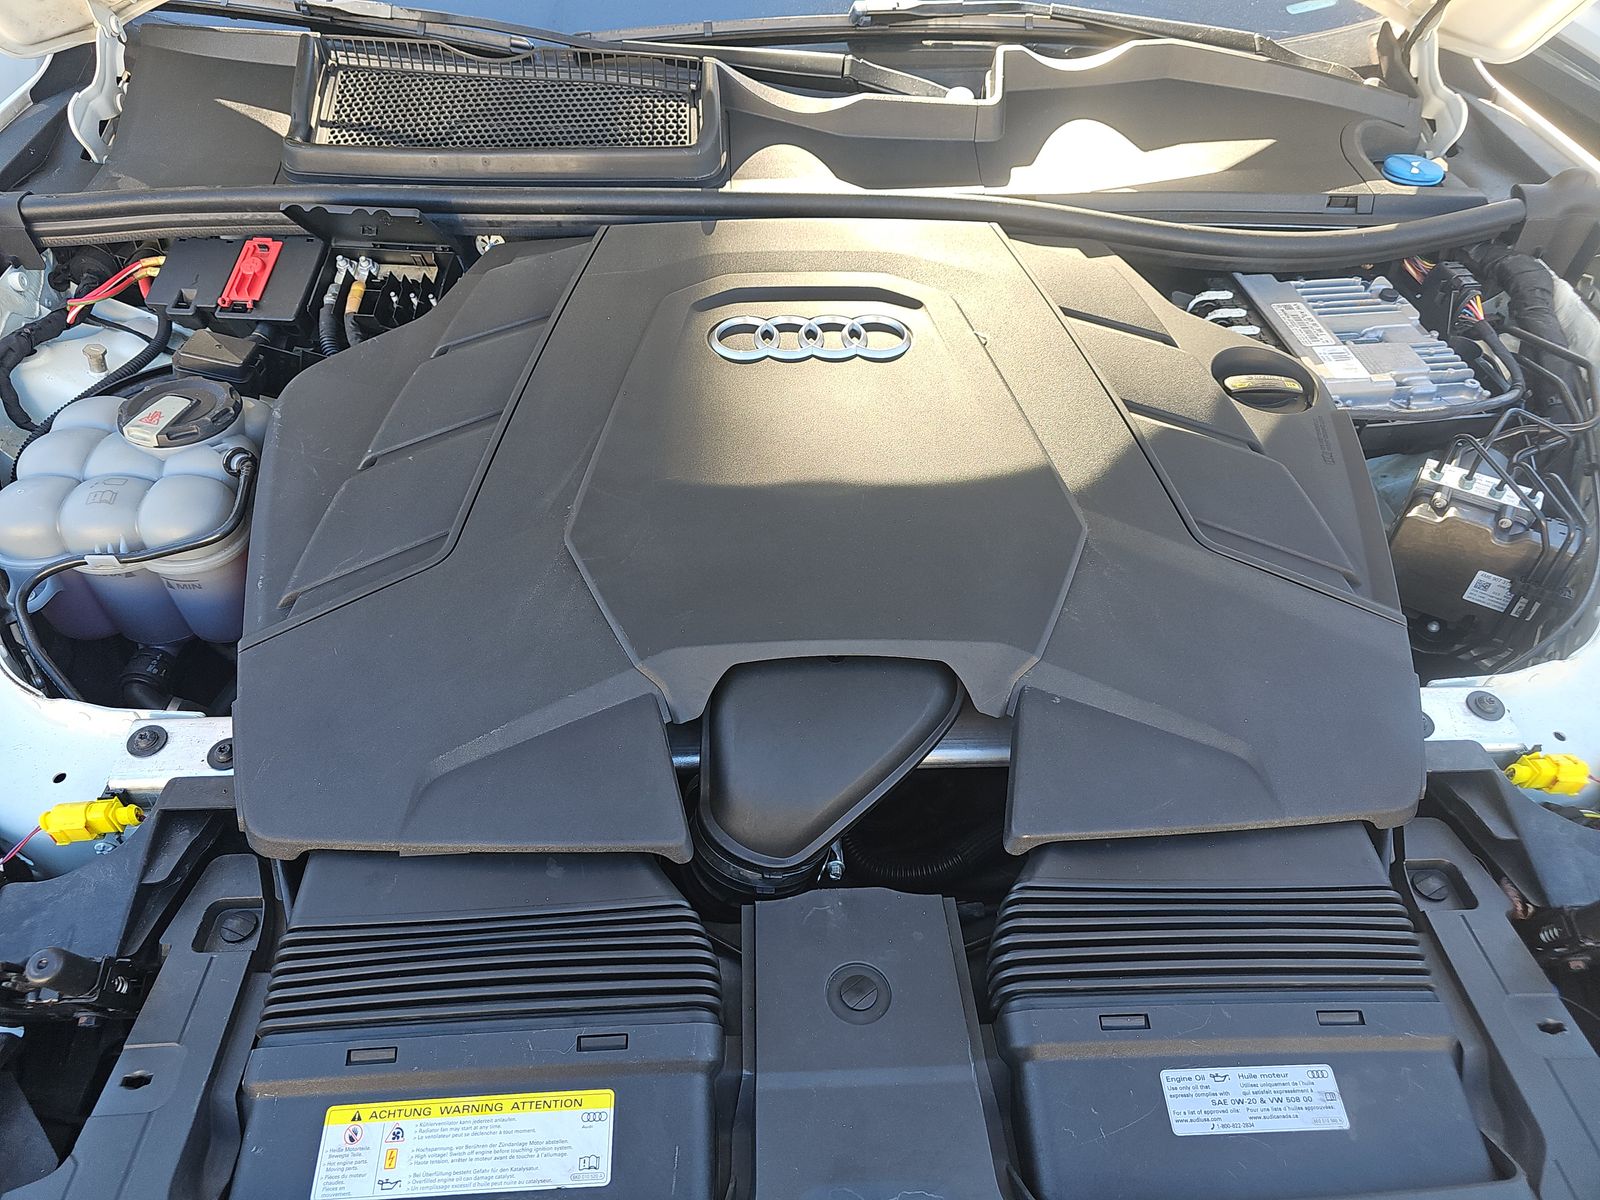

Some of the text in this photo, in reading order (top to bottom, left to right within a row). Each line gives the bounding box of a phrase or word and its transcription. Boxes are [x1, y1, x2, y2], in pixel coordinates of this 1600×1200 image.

[369, 1098, 582, 1120] ACHTUNG WARNING ATTENTION
